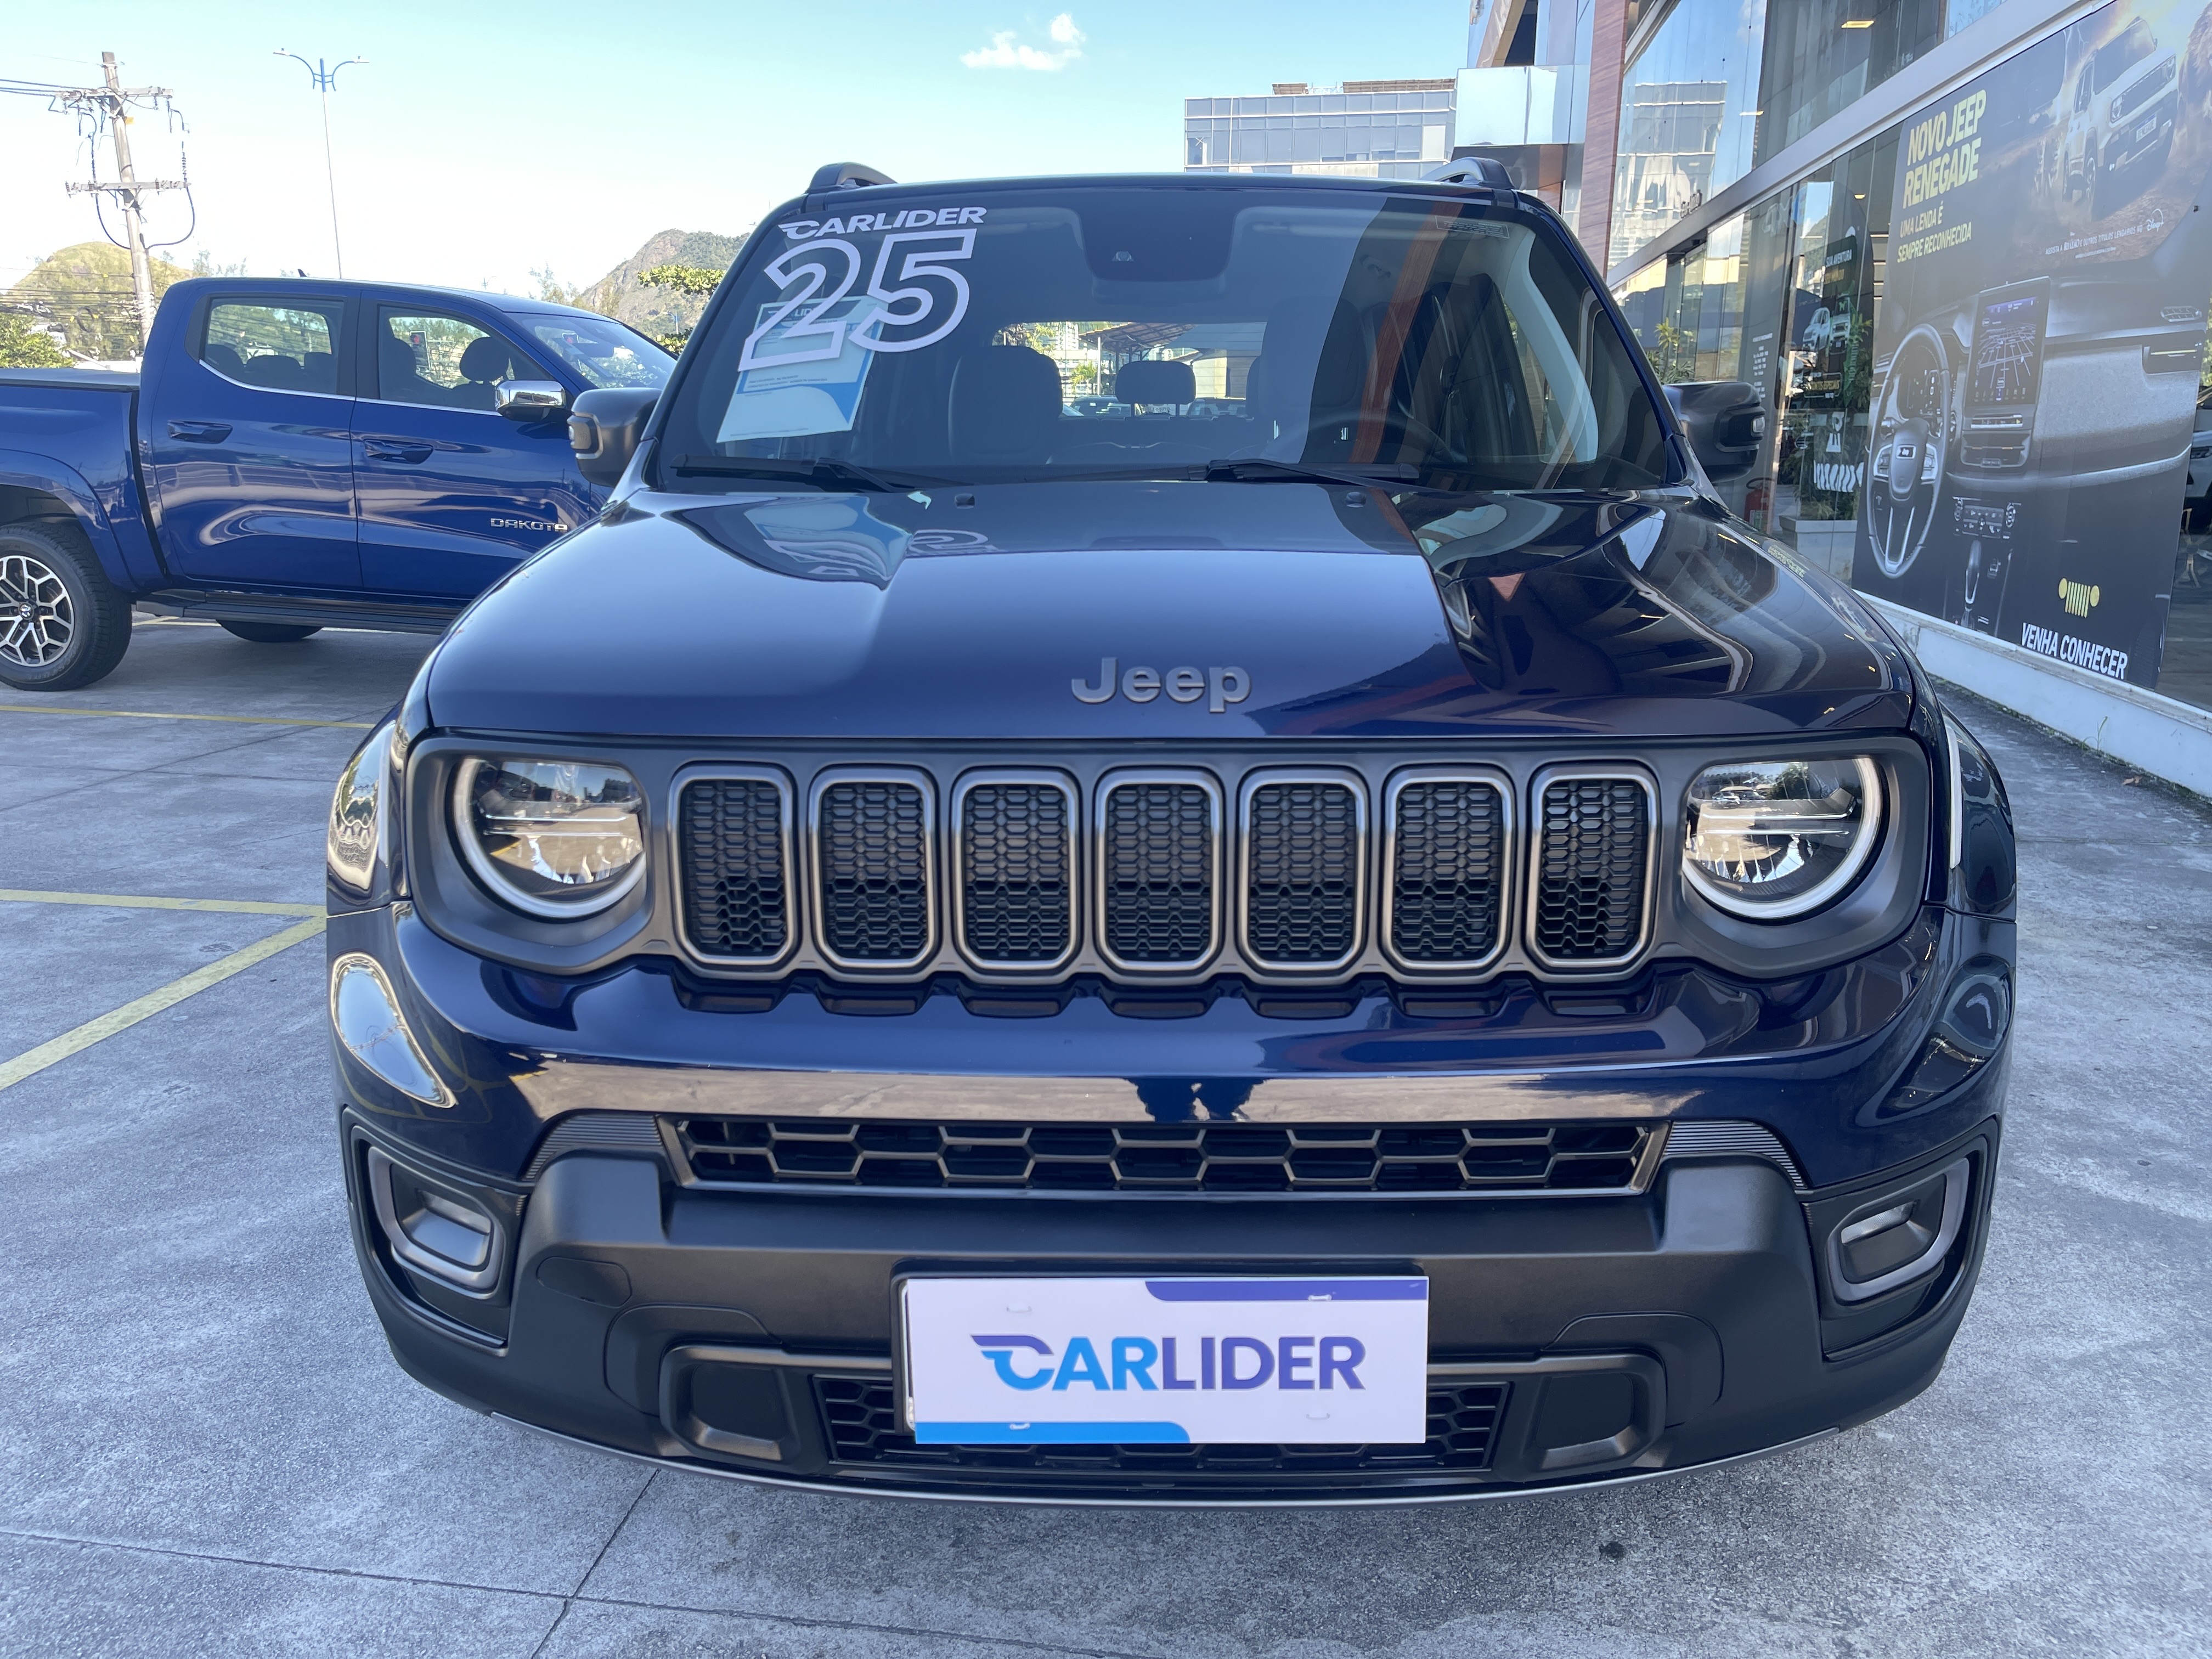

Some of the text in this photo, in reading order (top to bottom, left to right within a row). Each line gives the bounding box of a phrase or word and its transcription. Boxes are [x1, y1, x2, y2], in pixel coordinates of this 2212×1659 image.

[1907, 89, 1987, 166] NOVO JEEP
[1903, 137, 1982, 209] RENEGADE
[778, 206, 987, 240] CARLIDER
[1897, 221, 1972, 263] SEMPRE RECONHECIDA
[1900, 200, 1944, 238] UMA LENDA É
[738, 228, 977, 371] 25
[490, 518, 568, 533] DAKOTA
[2022, 622, 2128, 680] VENHA CONHECER
[1071, 657, 1252, 713] Jeep
[970, 1334, 1367, 1391] CARLIDER
